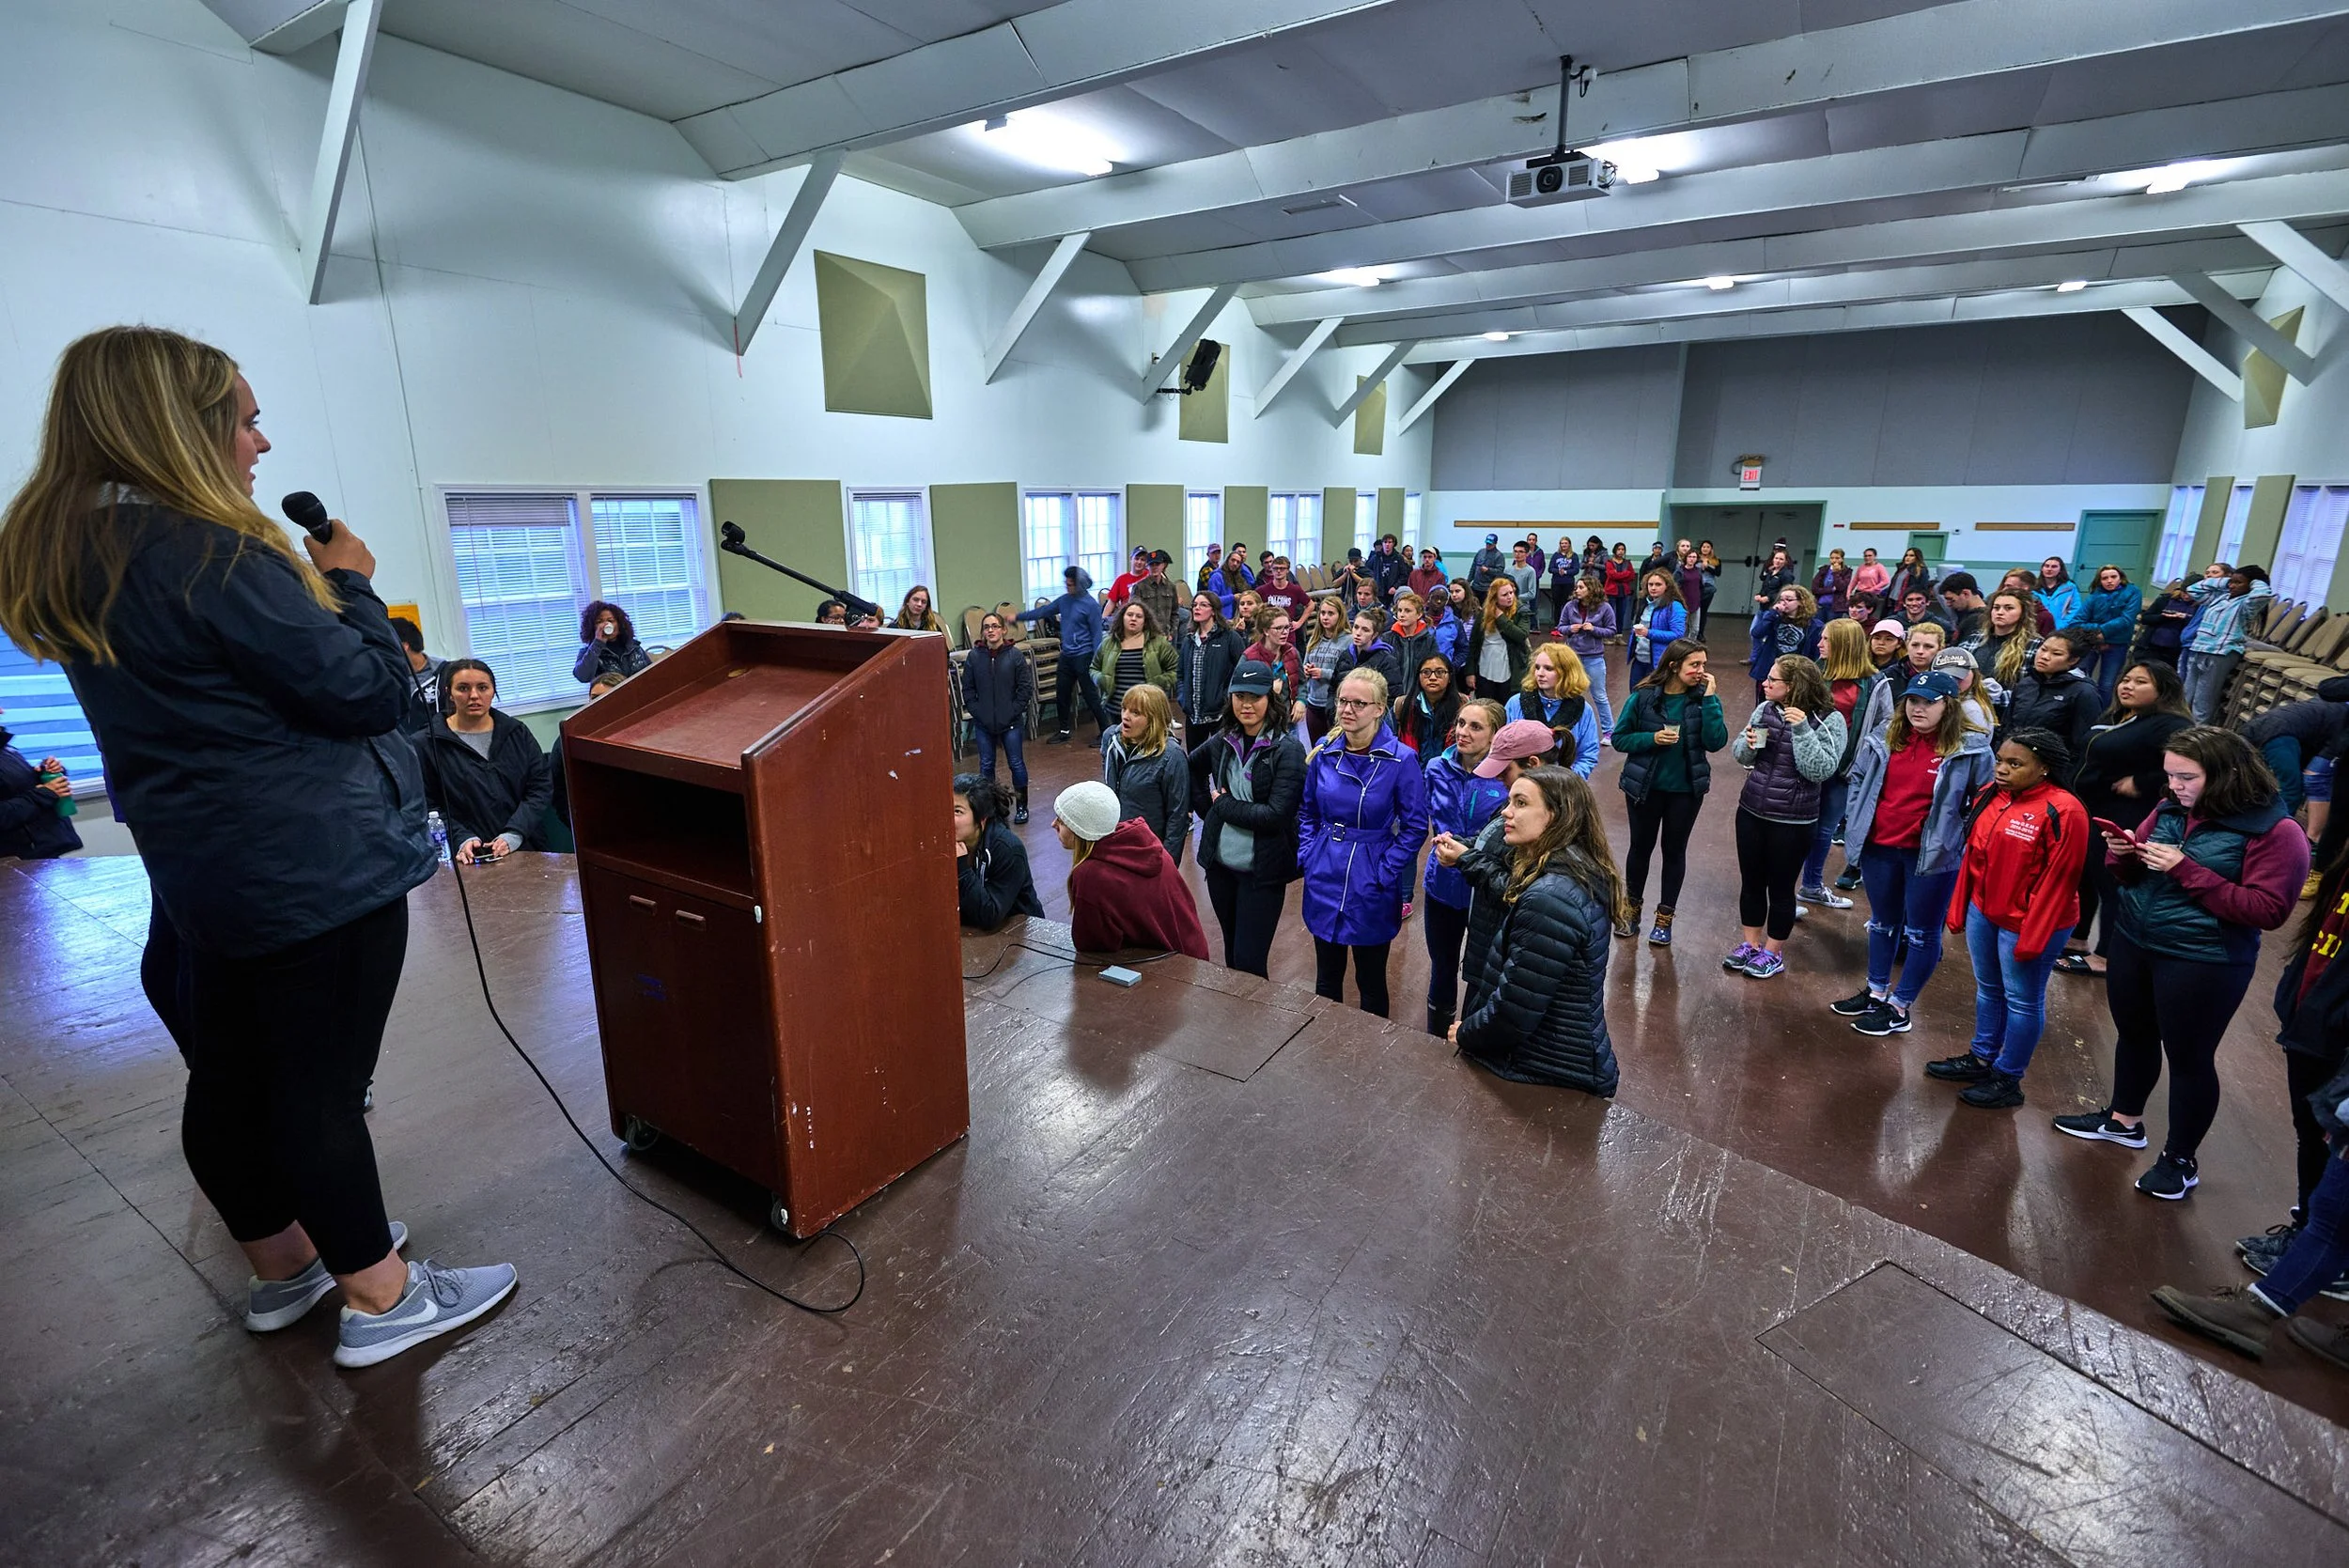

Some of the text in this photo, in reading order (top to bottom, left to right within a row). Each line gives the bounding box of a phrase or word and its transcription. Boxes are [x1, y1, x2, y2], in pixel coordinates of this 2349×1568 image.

[1743, 470, 1759, 480] EXIT
[1937, 655, 1964, 665] Falcons
[1917, 675, 1929, 686] S
